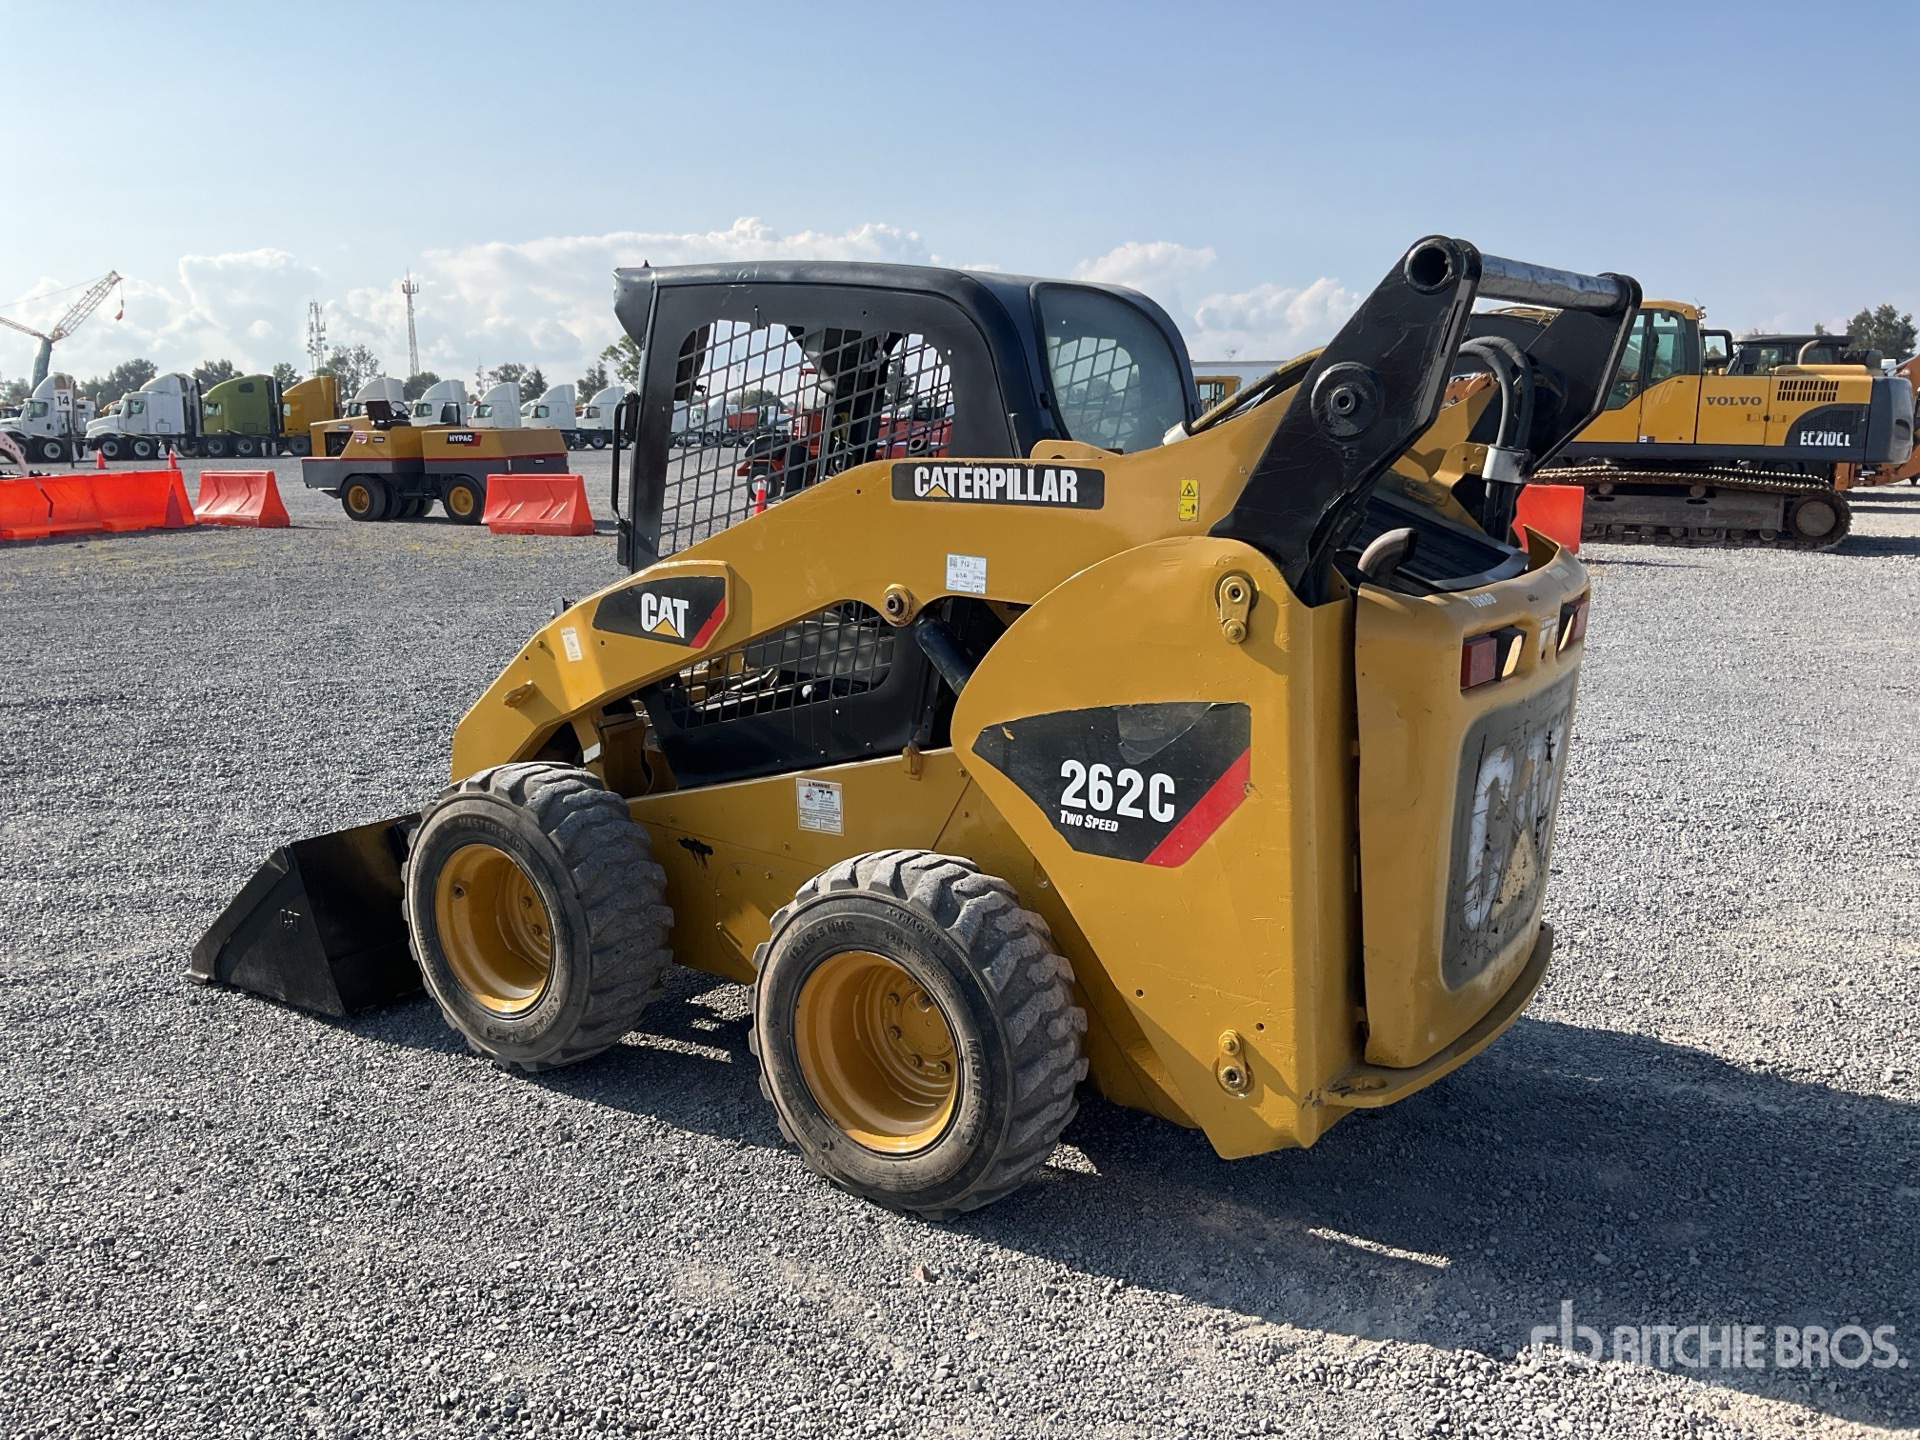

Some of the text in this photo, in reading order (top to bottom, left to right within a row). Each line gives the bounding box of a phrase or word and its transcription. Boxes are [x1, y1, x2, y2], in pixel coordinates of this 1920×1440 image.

[57, 395, 70, 406] 14
[1706, 396, 1763, 406] VOLVO
[449, 434, 473, 442] HYPAC
[1800, 430, 1851, 447] EC210CL
[914, 466, 1078, 503] CATERPILLAR
[641, 592, 689, 639] CAT
[1060, 759, 1176, 823] 262C
